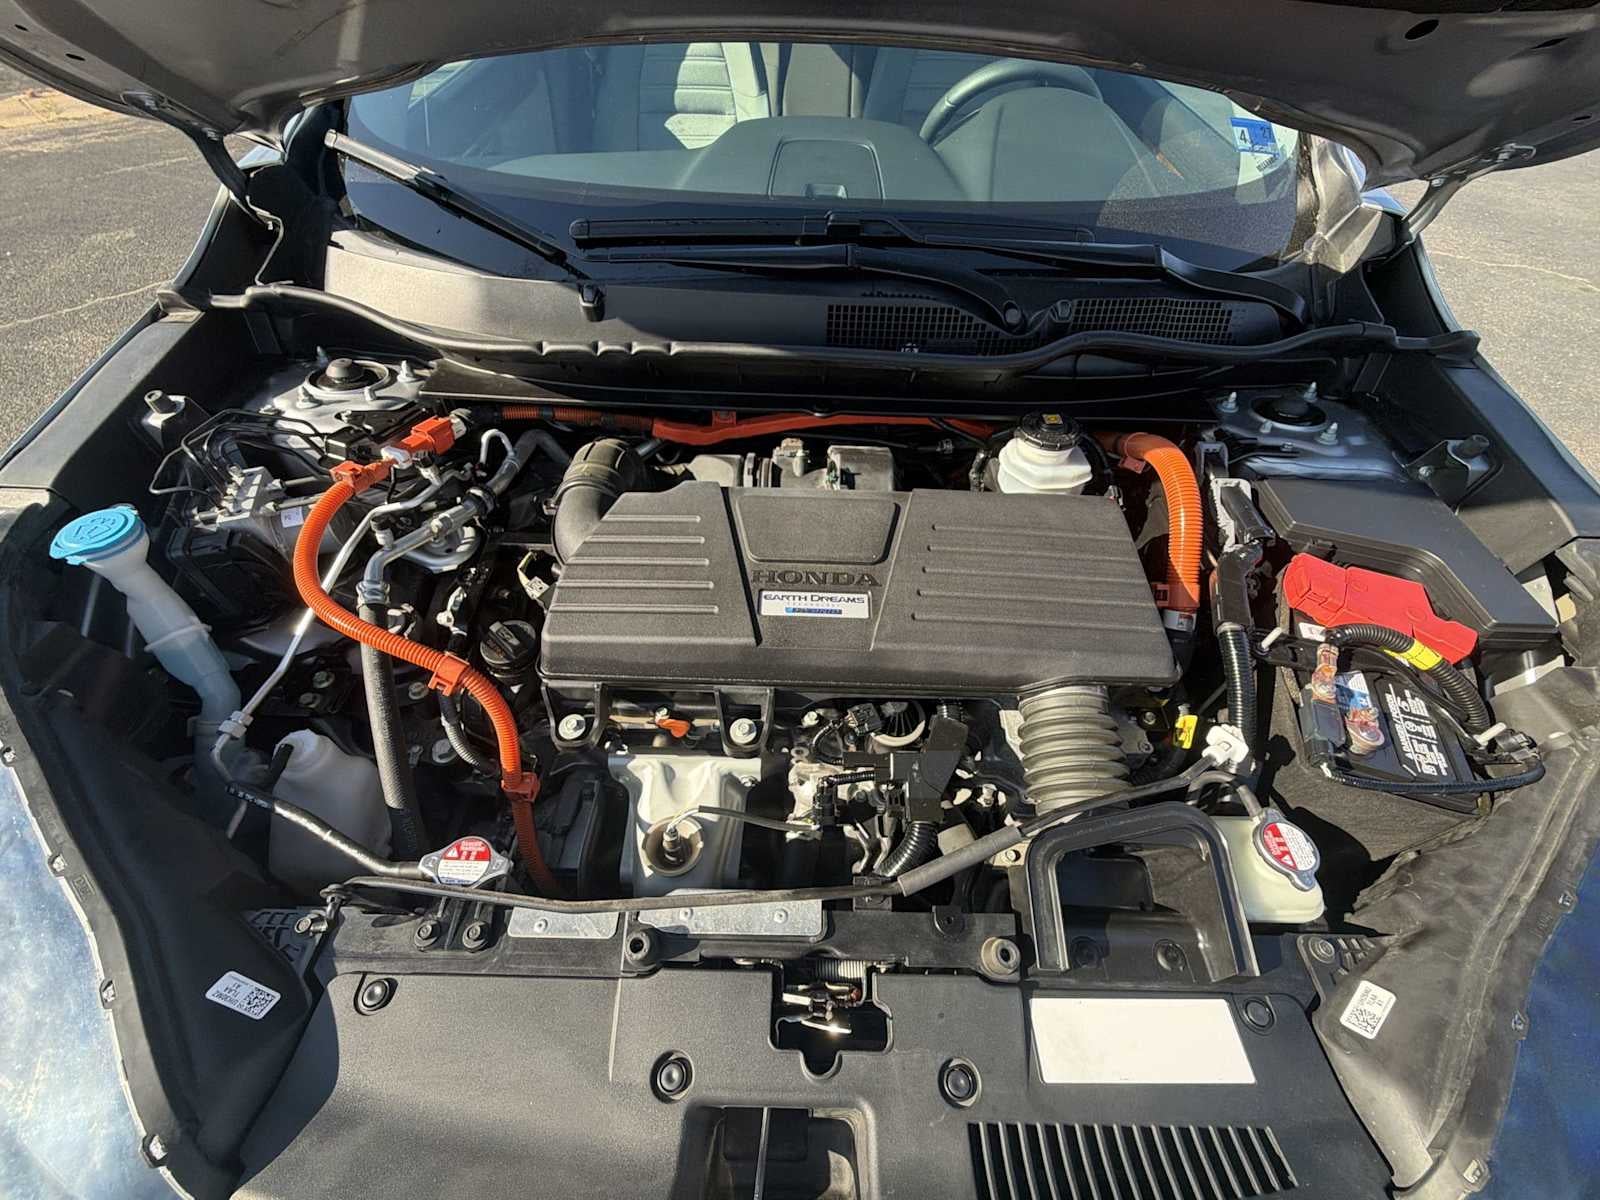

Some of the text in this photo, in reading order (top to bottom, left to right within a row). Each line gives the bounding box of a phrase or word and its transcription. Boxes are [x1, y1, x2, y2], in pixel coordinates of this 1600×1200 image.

[1239, 129, 1248, 143] 4
[751, 570, 882, 587] HONDA
[763, 594, 865, 603] EARTH DREAMS
